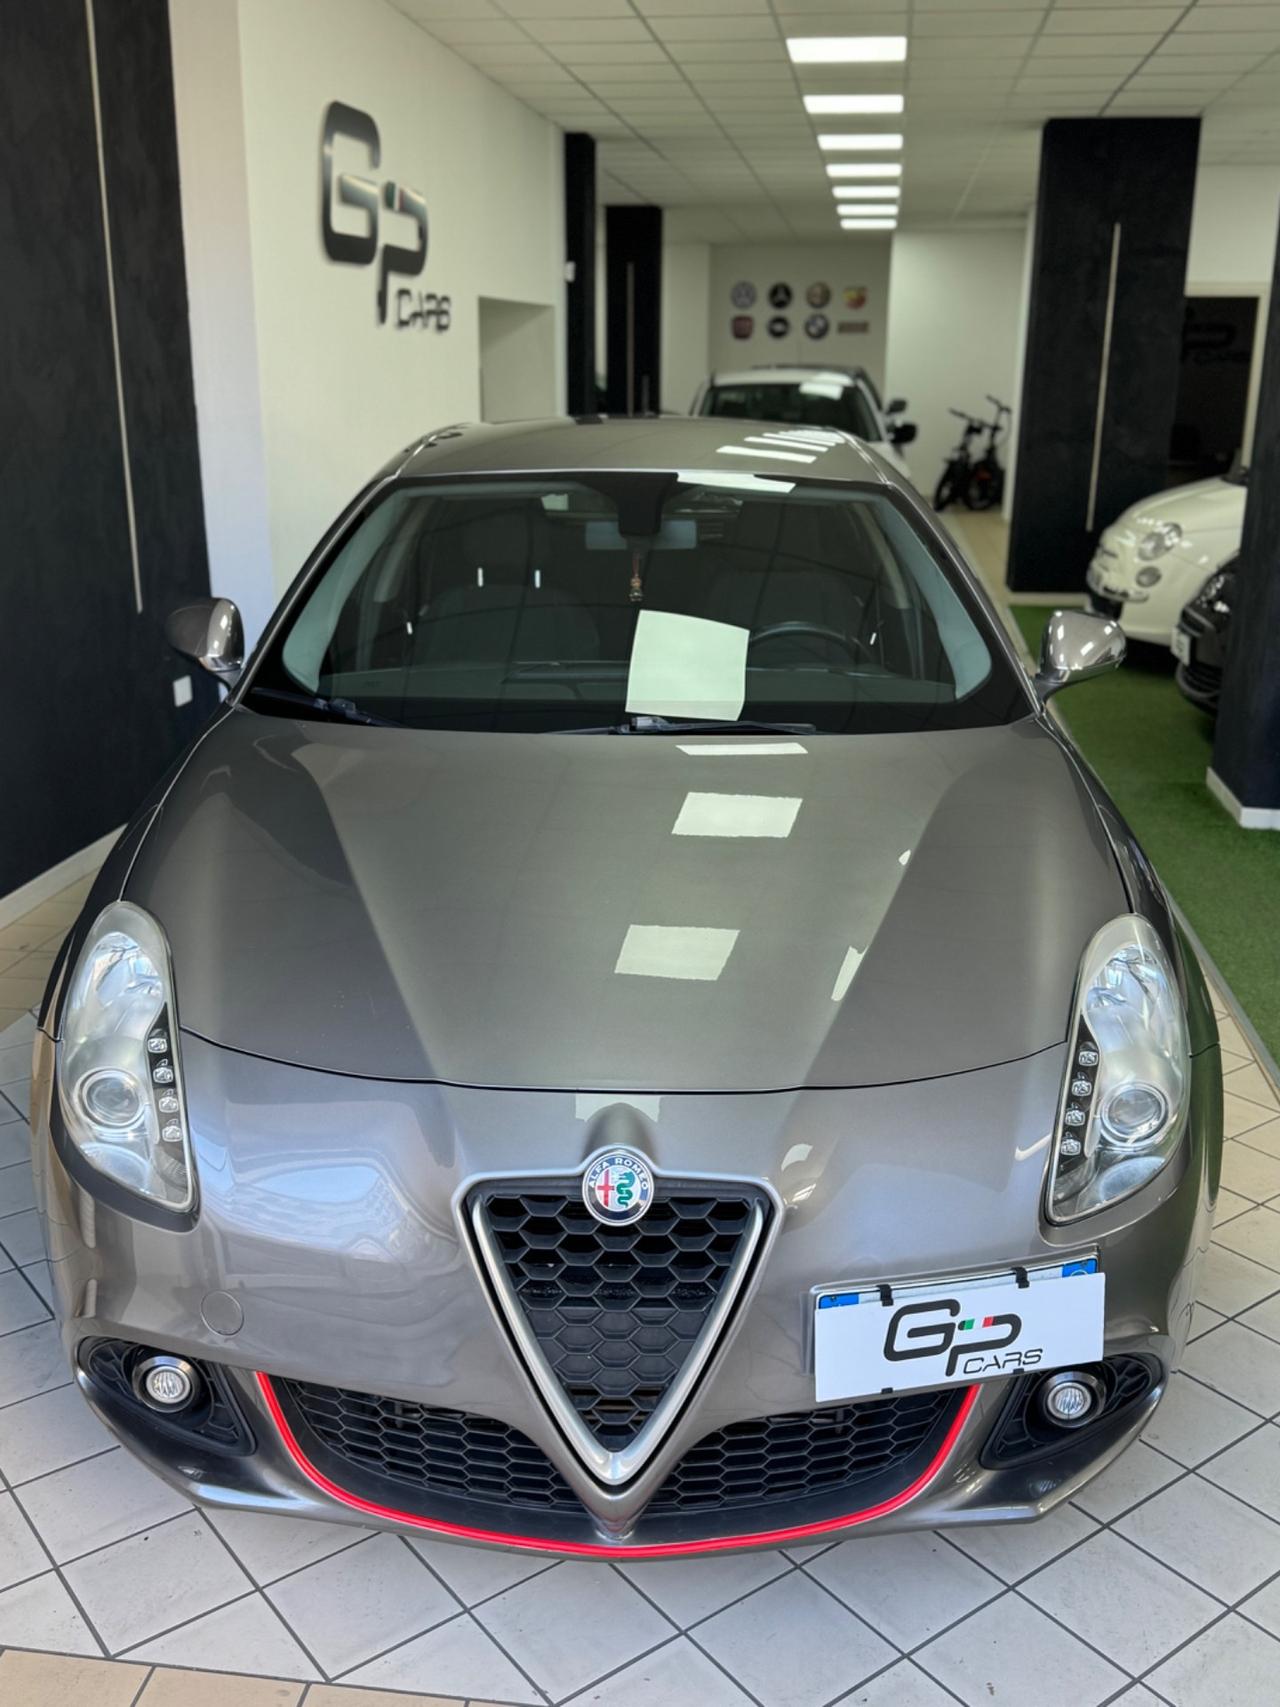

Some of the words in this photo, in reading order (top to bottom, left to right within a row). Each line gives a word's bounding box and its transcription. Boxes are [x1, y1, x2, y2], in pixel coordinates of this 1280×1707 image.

[396, 288, 451, 332] CARS
[588, 1160, 610, 1188] ALFA
[614, 1157, 649, 1190] ROMEO
[883, 1298, 1023, 1377] GP
[962, 1348, 1044, 1374] CARS
